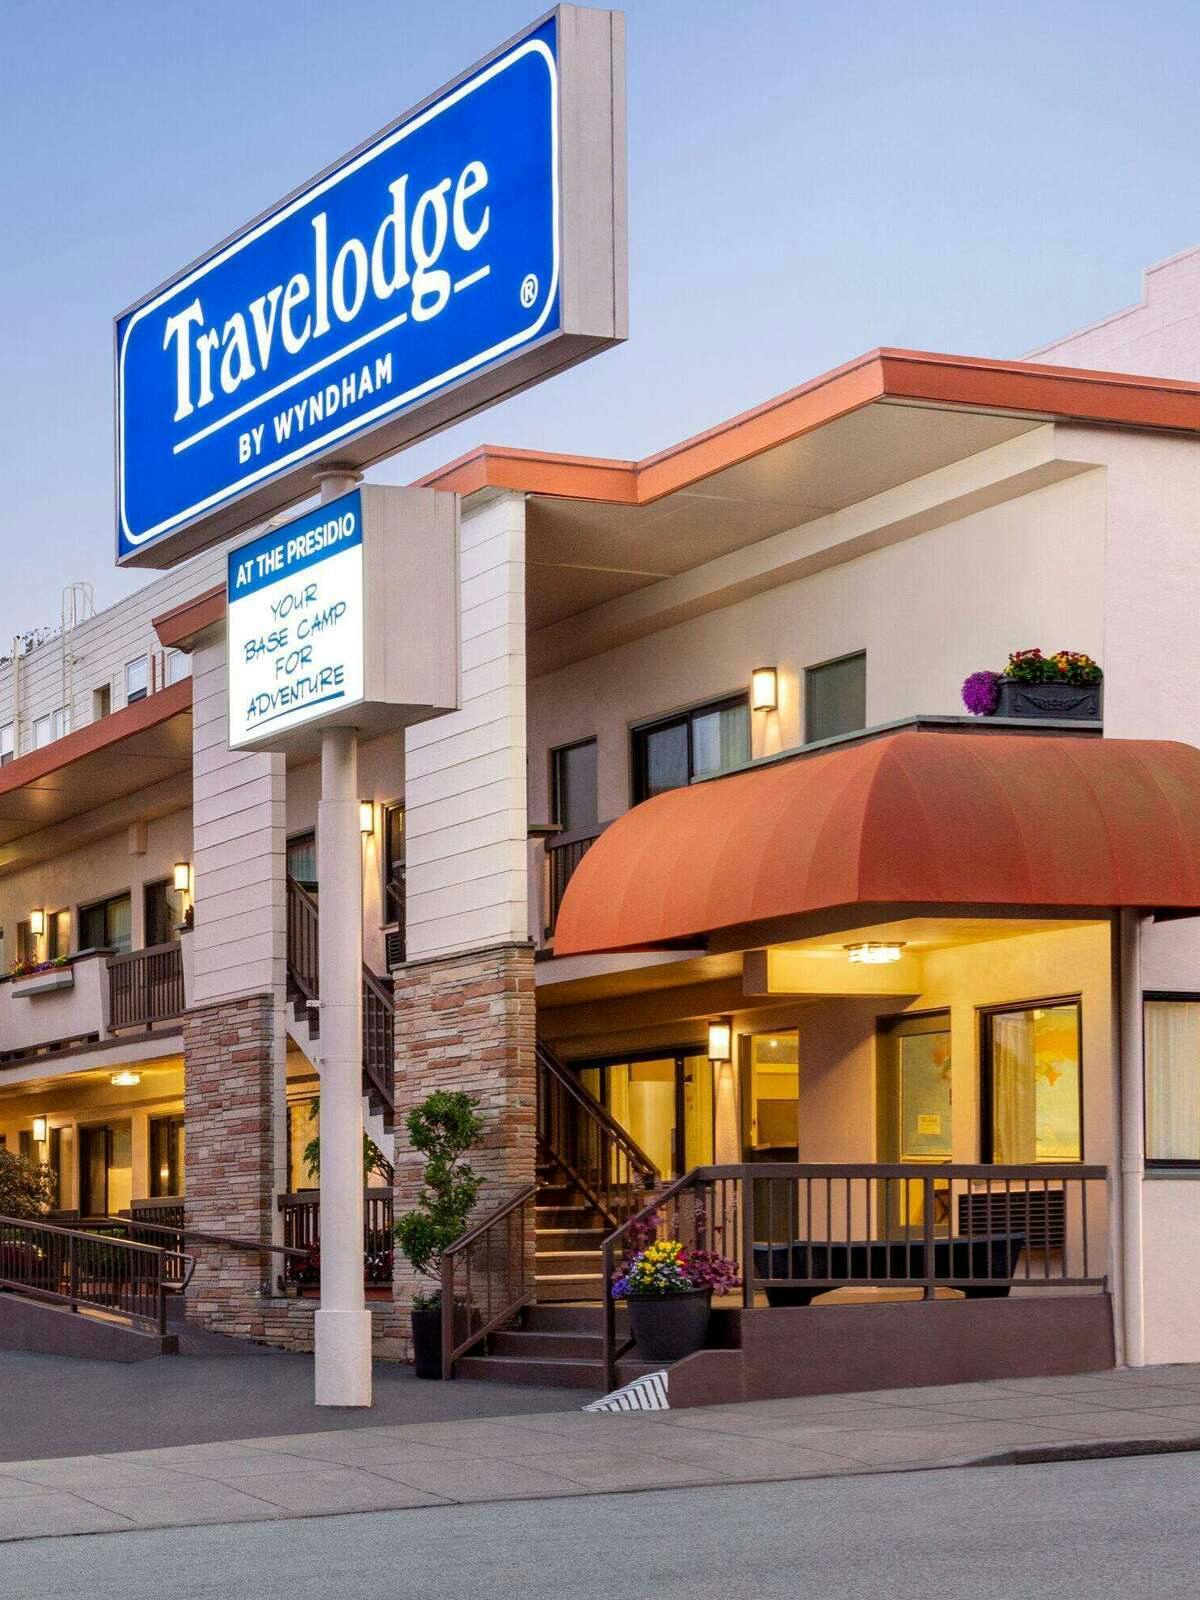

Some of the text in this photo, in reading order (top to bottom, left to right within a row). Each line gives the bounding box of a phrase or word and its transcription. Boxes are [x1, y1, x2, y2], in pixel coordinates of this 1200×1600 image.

[162, 160, 490, 422] Travelodge
[239, 352, 393, 464] BY WYNDHAM
[235, 512, 356, 588] AT THE PRESIDIO
[244, 601, 347, 664] BASE CAMP
[270, 583, 317, 621] YOUR
[246, 664, 345, 721] ADVENTURE
[275, 645, 313, 680] FOR
